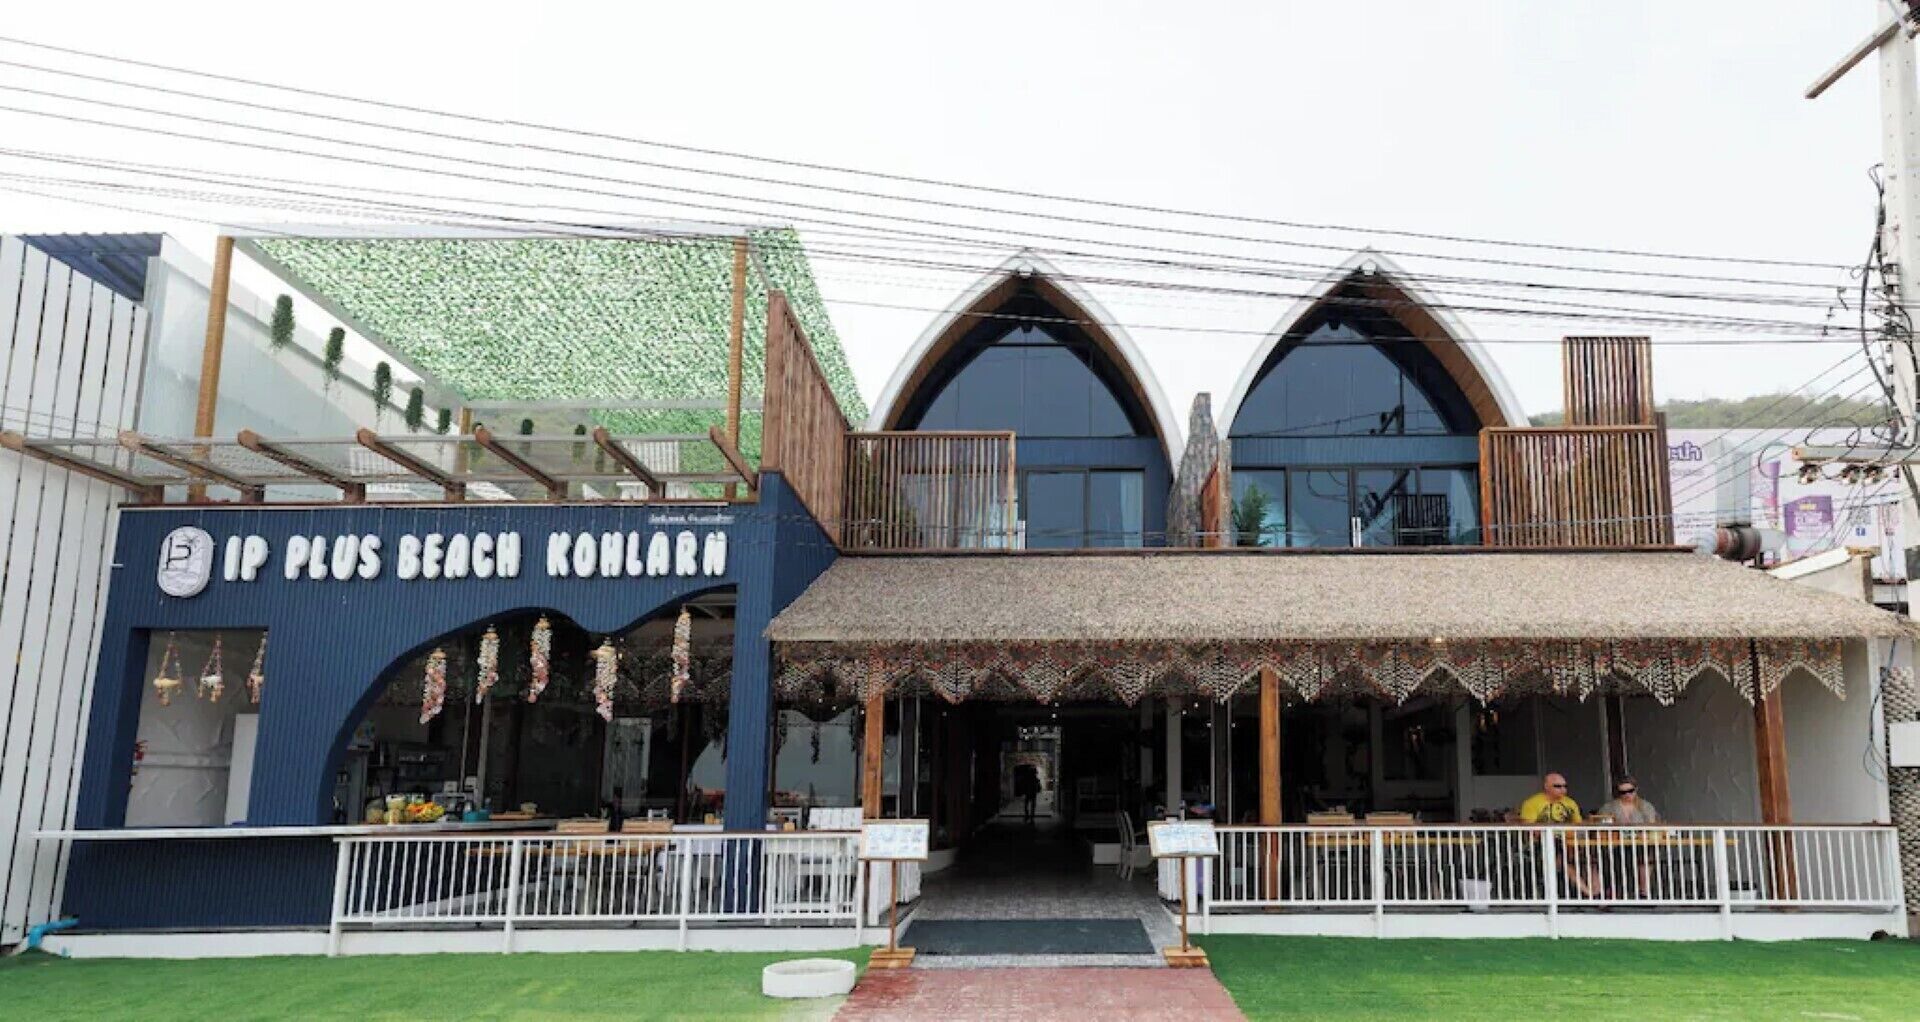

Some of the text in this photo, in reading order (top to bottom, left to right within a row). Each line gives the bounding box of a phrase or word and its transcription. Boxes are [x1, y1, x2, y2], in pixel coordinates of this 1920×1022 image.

[224, 535, 268, 581] IP
[285, 534, 381, 579] PLUS
[398, 532, 521, 578] BEACH
[547, 531, 727, 577] KOHLARN
